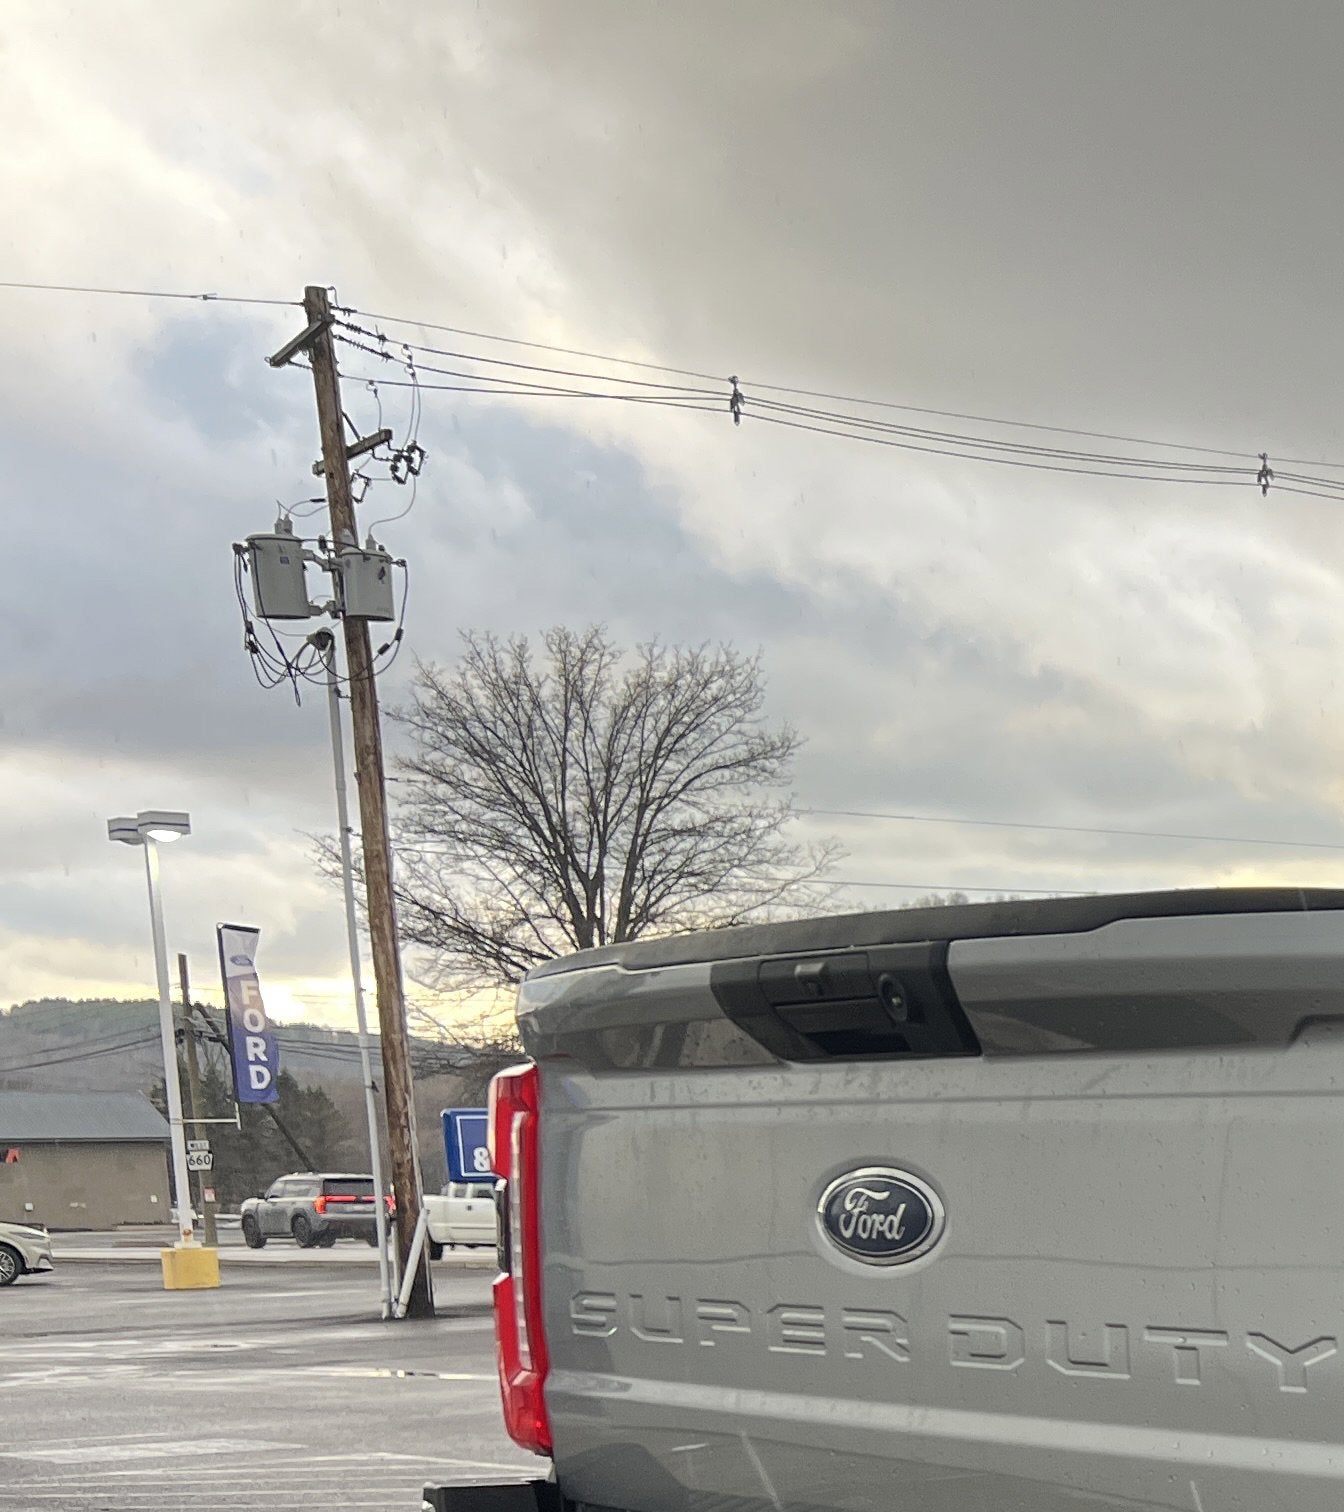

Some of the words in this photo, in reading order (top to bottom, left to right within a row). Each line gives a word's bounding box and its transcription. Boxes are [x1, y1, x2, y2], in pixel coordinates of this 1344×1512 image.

[239, 979, 272, 1091] FORD
[189, 1154, 211, 1166] 660
[839, 1187, 907, 1241] Ford
[570, 1291, 911, 1363] SUPER
[948, 1313, 1338, 1393] DUTY
